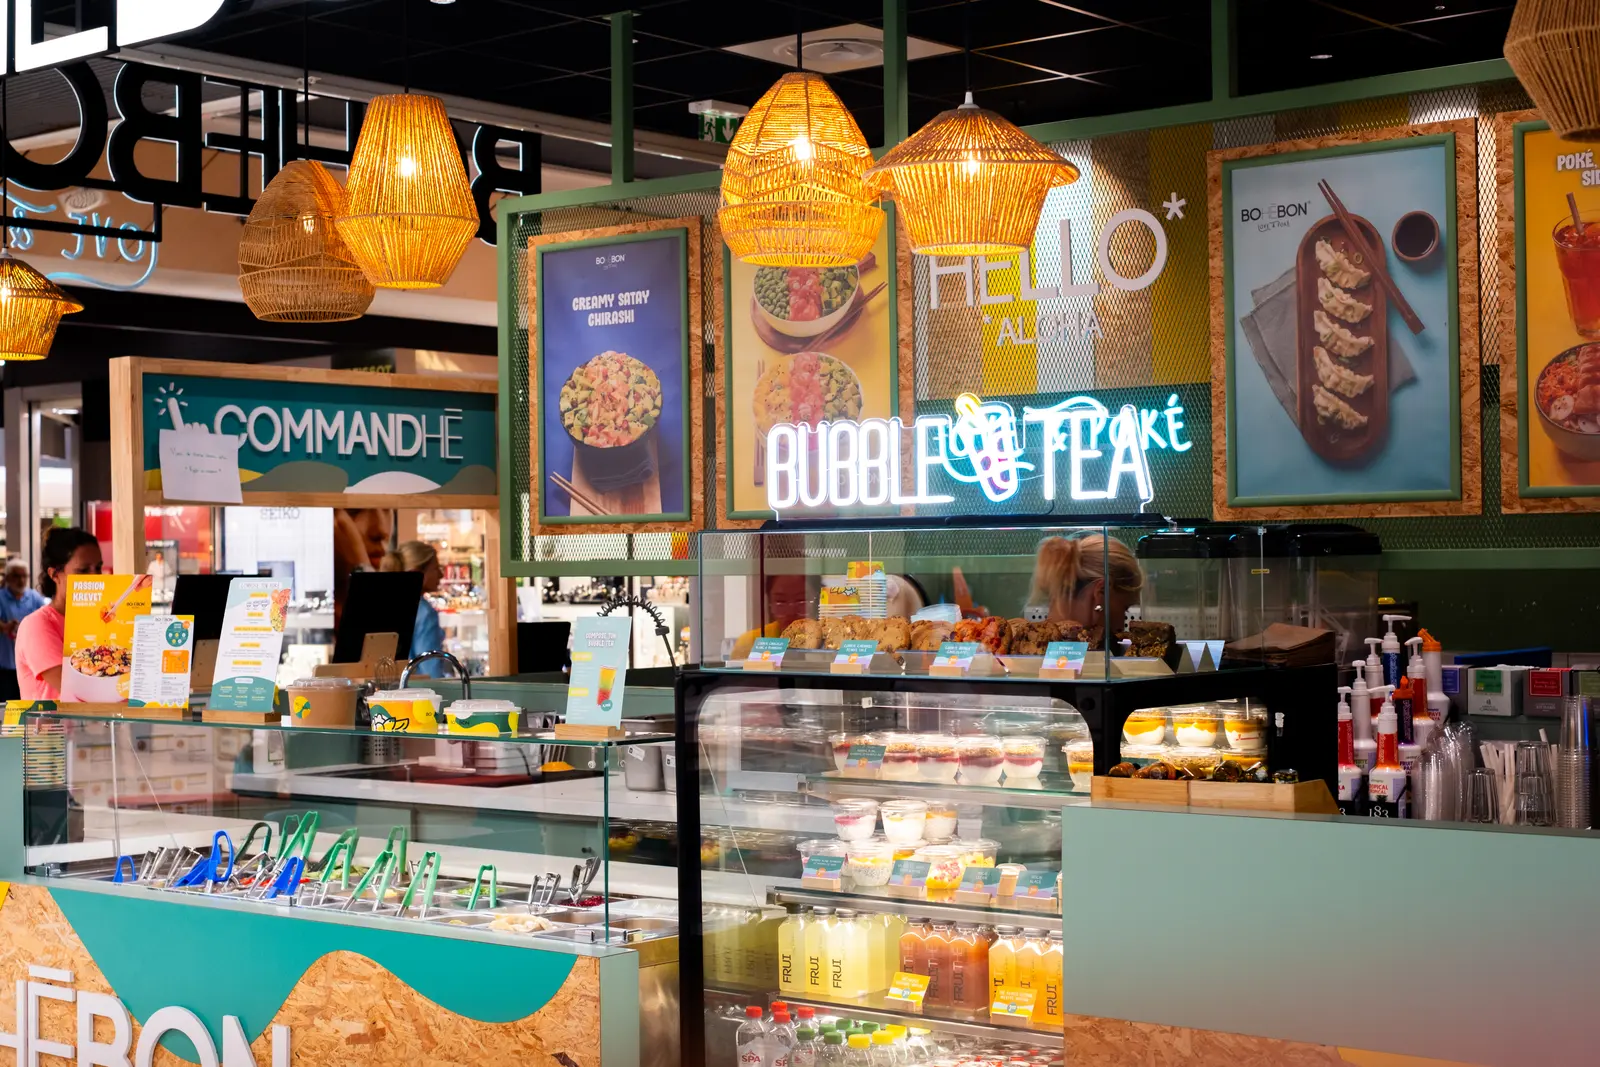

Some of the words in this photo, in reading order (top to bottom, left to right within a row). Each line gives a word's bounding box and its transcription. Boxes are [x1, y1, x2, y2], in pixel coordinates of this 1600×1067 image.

[572, 293, 615, 311] CREAMY
[618, 289, 650, 306] SATAY
[588, 309, 635, 327] CHIRASHI
[767, 413, 955, 508] BUBBLE
[1024, 404, 1152, 501] TEA
[260, 507, 300, 521] SEIKO
[73, 581, 105, 590] PASSION
[72, 592, 103, 602] KREVET
[741, 1054, 761, 1064] SPA
